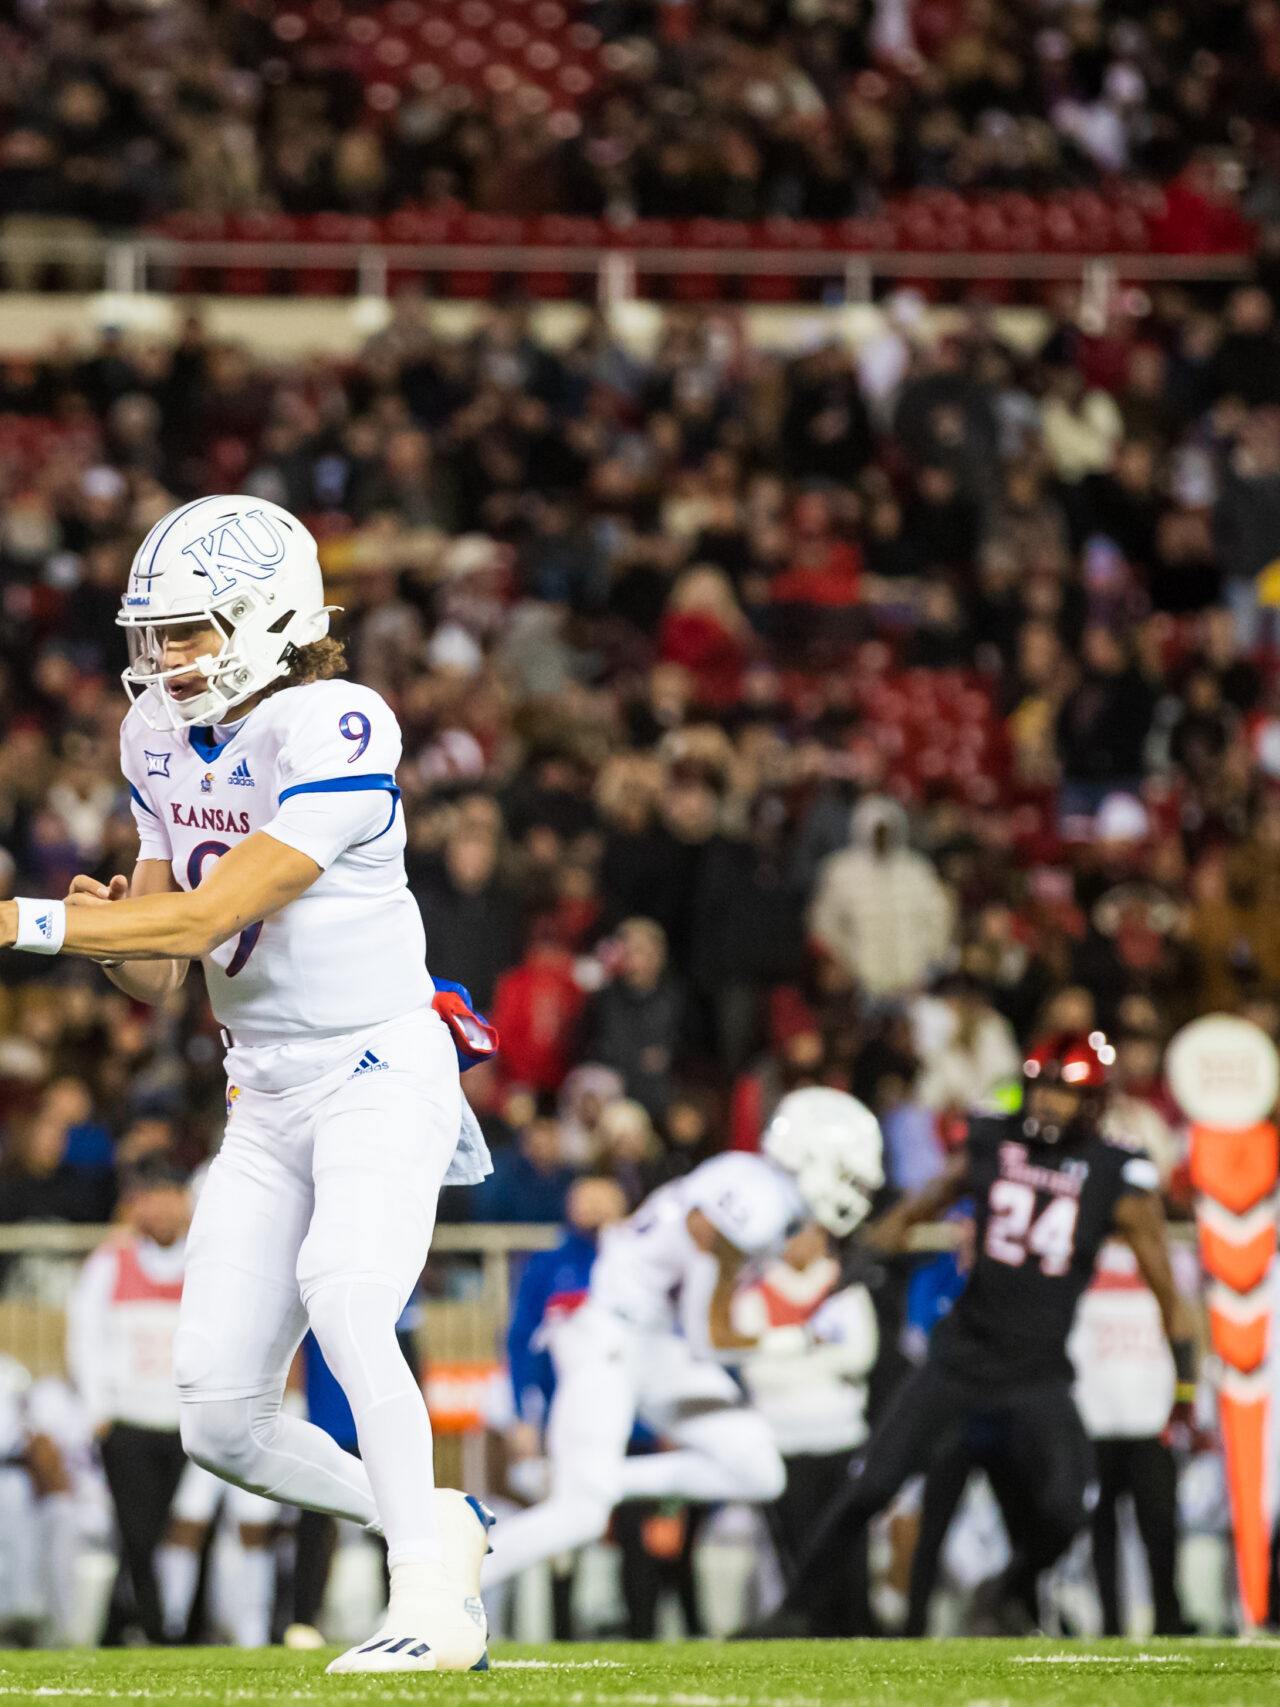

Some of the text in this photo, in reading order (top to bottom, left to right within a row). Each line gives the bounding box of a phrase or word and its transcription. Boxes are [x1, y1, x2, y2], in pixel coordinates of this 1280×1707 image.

[181, 509, 286, 597] KU
[338, 711, 372, 764] 9
[227, 776, 256, 787] adidas
[170, 802, 251, 835] KANSAS
[986, 1178, 1079, 1278] 24
